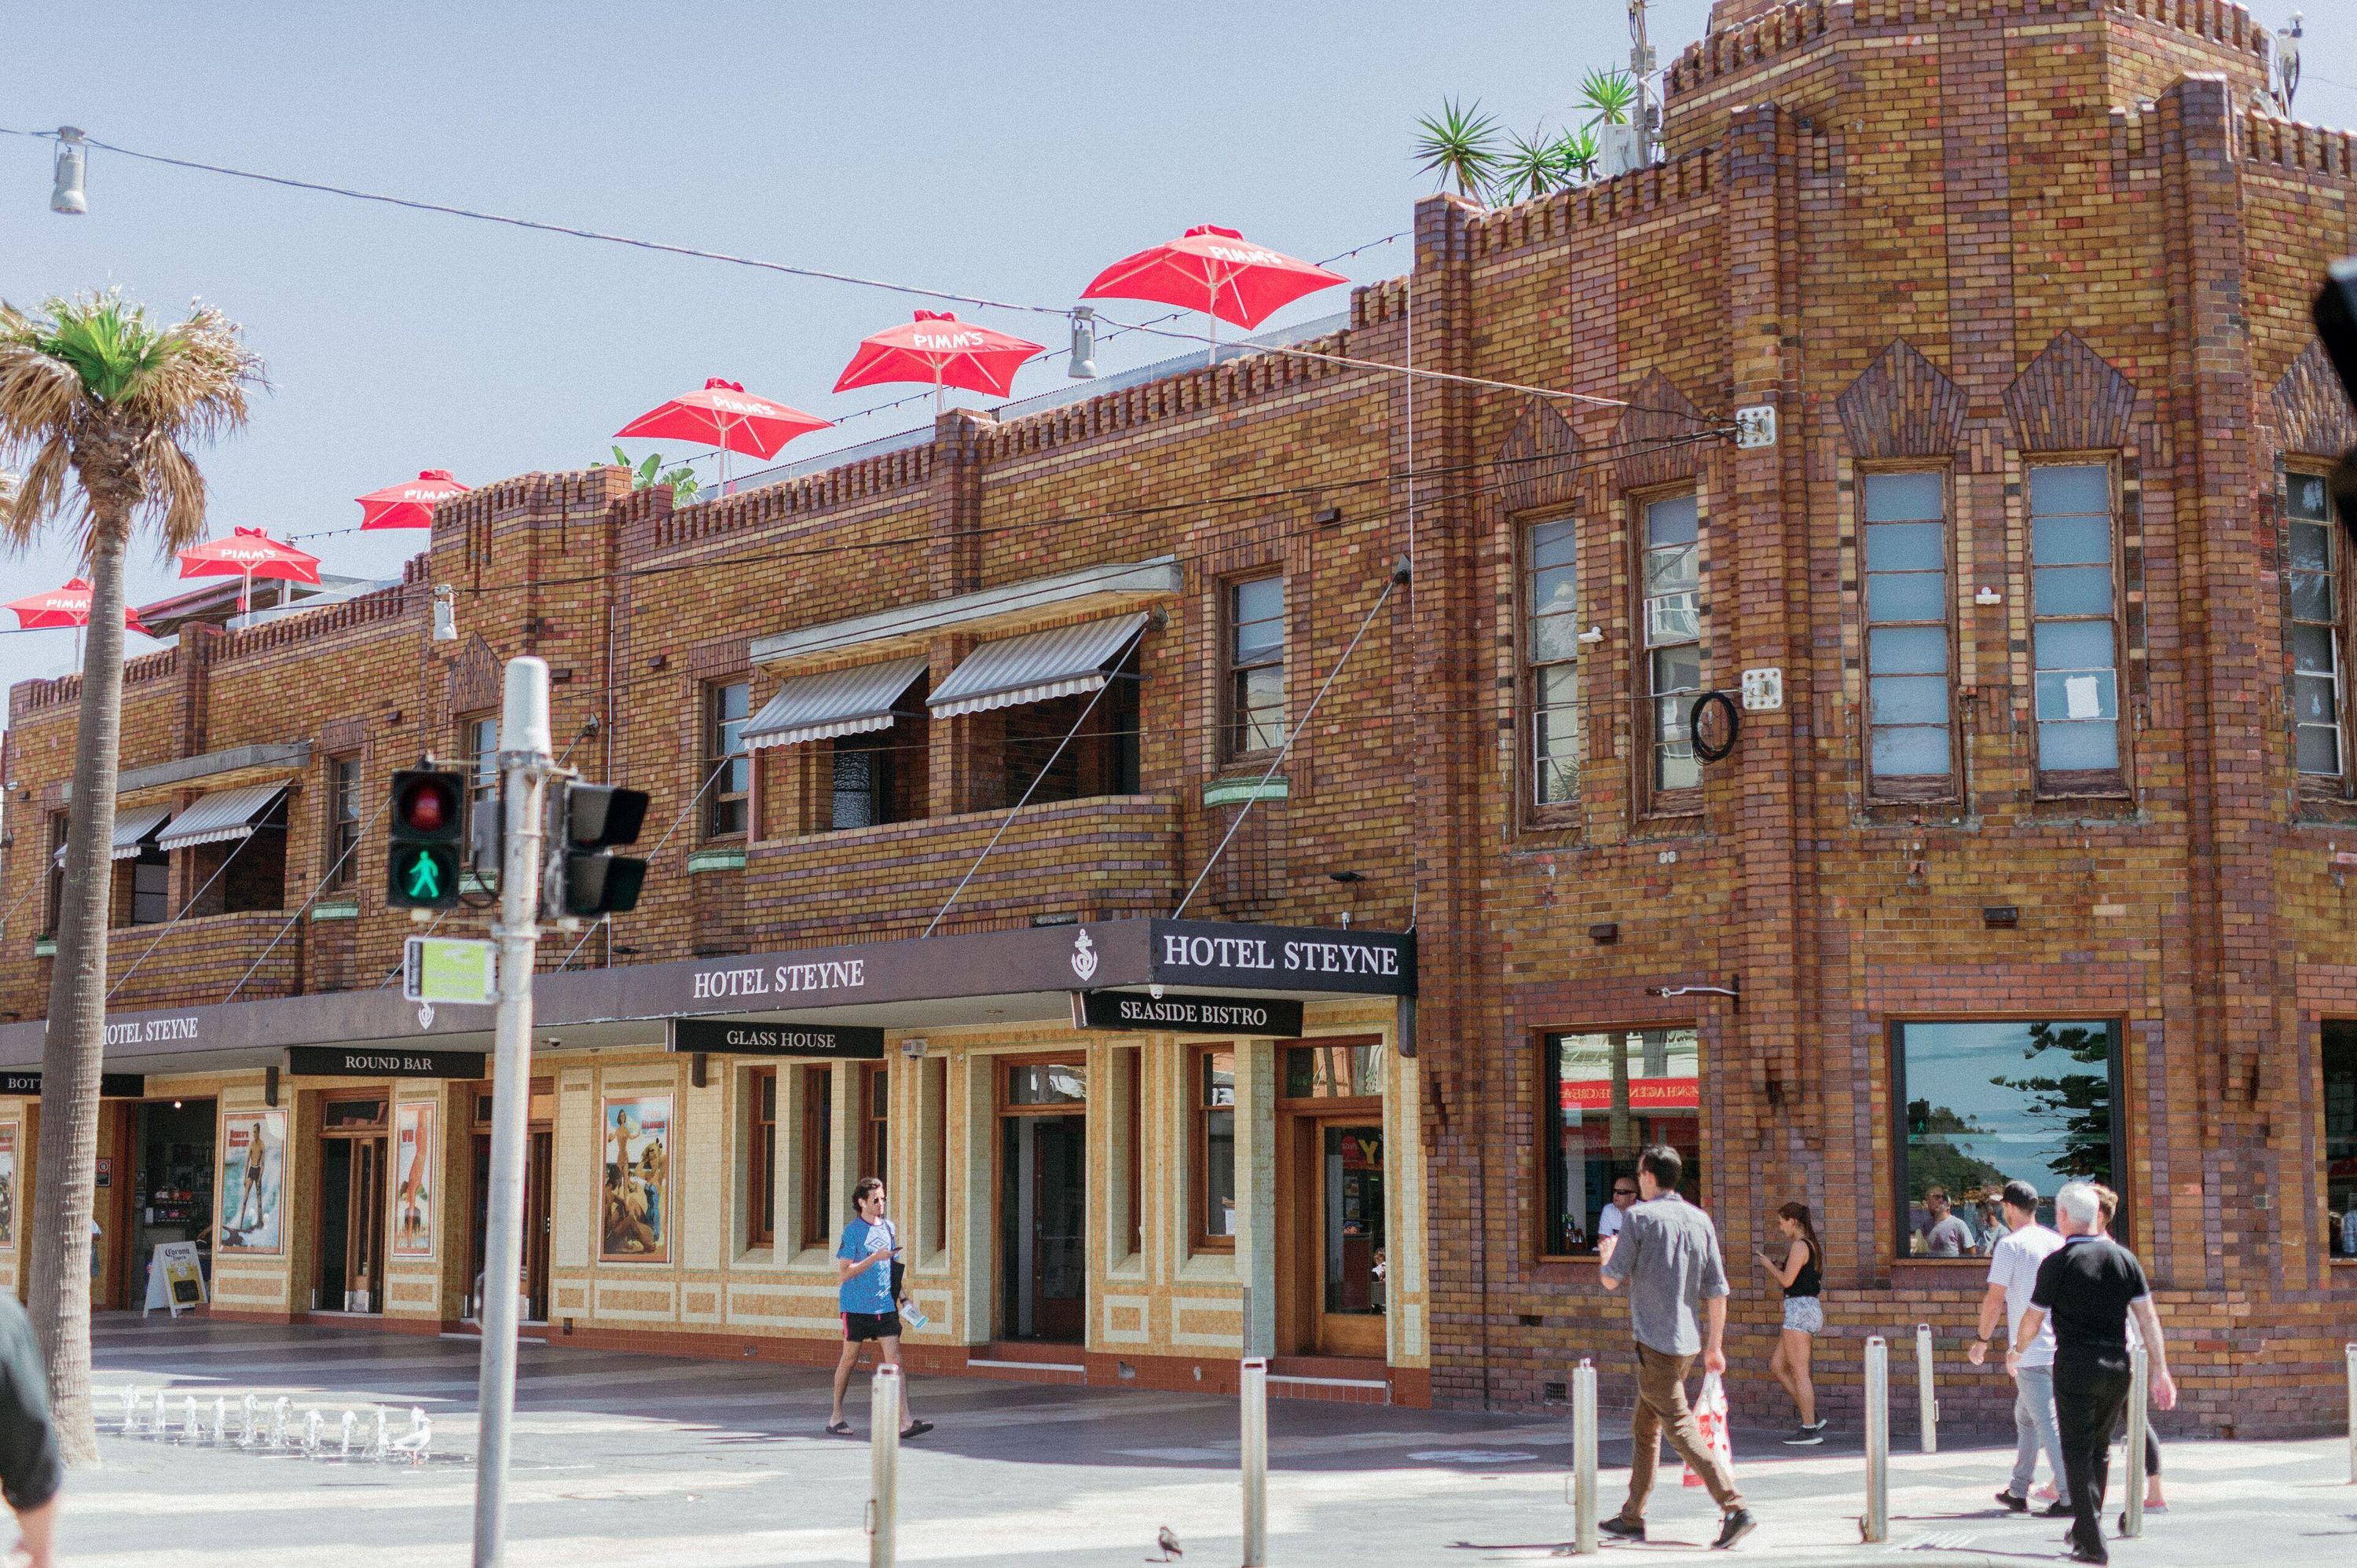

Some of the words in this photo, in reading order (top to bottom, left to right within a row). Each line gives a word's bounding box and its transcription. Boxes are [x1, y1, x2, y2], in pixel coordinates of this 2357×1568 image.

[1208, 246, 1283, 264] PIMM'S
[913, 331, 984, 349] PIMM'S
[220, 548, 277, 559] PIMM'S
[46, 599, 91, 609] PIMM'
[1164, 935, 1274, 969] HOTEL
[1285, 940, 1399, 976] STEYNE
[693, 968, 769, 998] HOTEL
[775, 959, 864, 993] STEYNE
[1120, 1001, 1197, 1022] SEASIDE
[1201, 1006, 1267, 1026] BISTRO
[145, 1017, 199, 1042] STEYNE
[726, 1030, 777, 1046] GLASS
[781, 1032, 836, 1049] HOUSE
[345, 1056, 400, 1070] ROUND
[404, 1057, 433, 1070] BAR
[165, 1248, 190, 1258] Corona
